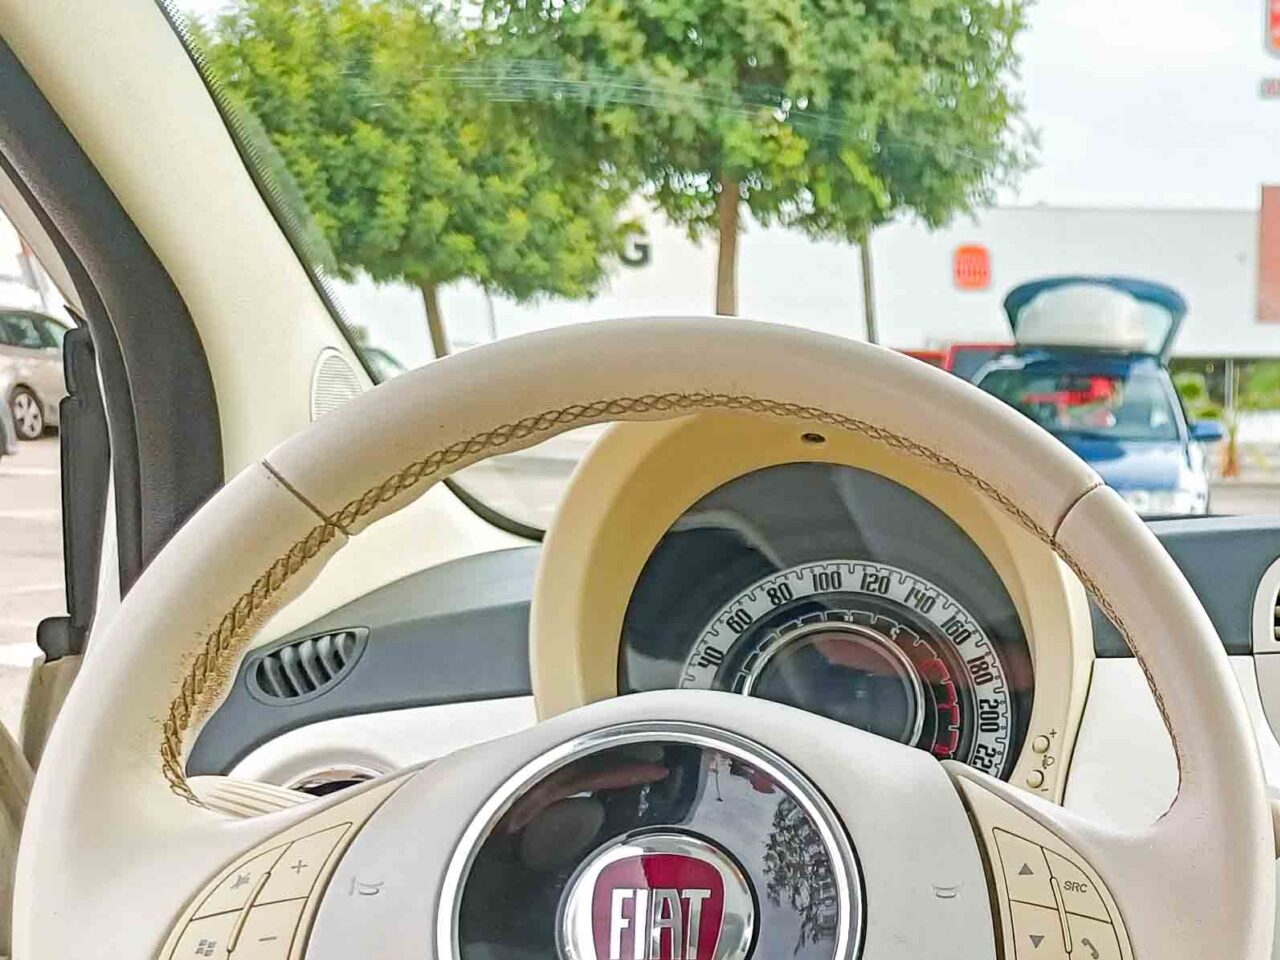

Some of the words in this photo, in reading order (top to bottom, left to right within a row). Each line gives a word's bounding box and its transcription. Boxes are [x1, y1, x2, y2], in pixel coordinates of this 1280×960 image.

[766, 582, 793, 606] 80
[812, 571, 842, 592] 100
[860, 572, 891, 594] 120
[903, 586, 937, 614] 140
[726, 608, 753, 634] 60
[940, 615, 972, 646] 160
[697, 645, 724, 668] 40
[966, 655, 994, 686] 180
[979, 699, 1000, 733] 200
[1063, 880, 1088, 894] SRC
[608, 888, 712, 960] FIAT
